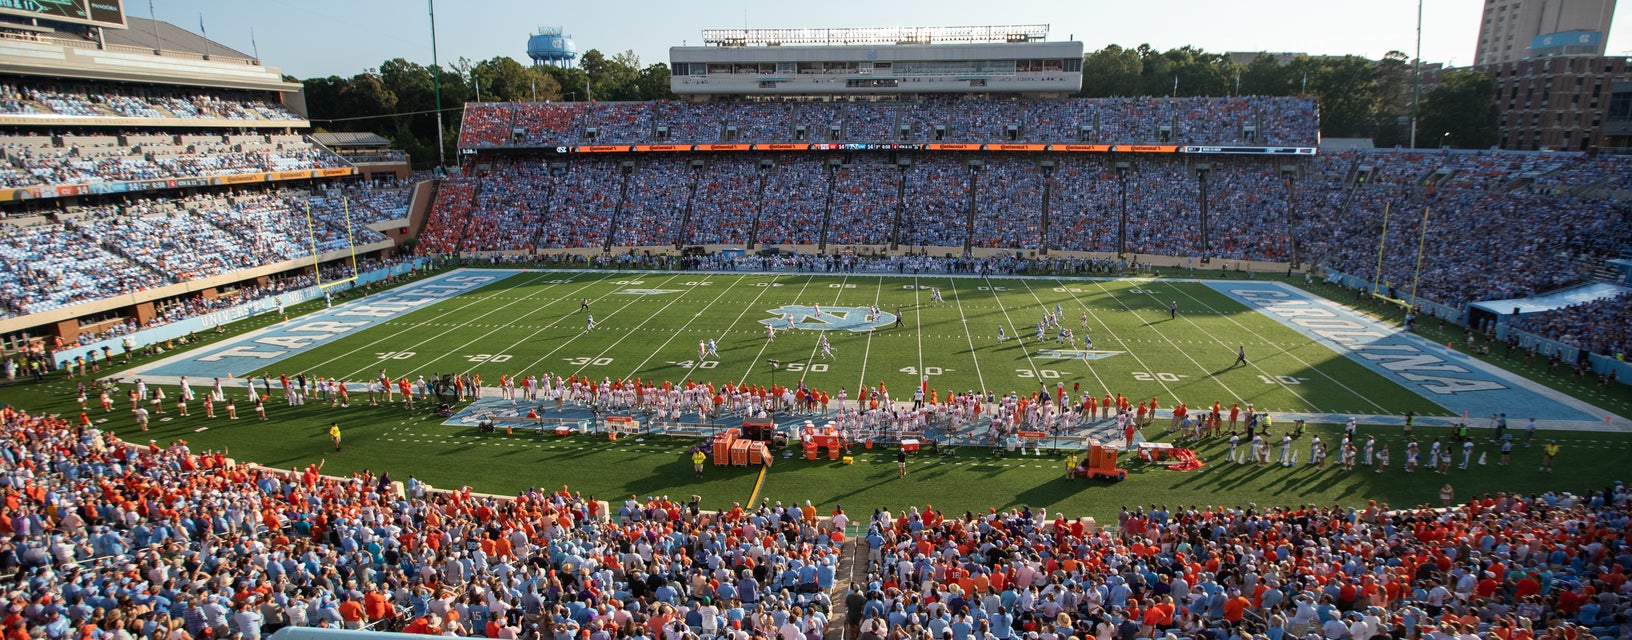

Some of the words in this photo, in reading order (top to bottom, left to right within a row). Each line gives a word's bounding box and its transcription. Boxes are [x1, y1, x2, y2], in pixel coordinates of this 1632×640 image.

[287, 287, 316, 303] NORTH
[195, 319, 372, 362] TAR
[333, 275, 498, 318] HEELS
[1228, 288, 1511, 396] CAROLINA
[376, 351, 416, 359] 10
[466, 354, 512, 362] 20
[571, 357, 614, 366] 30
[676, 360, 719, 369] 40
[786, 363, 828, 372] 50
[899, 366, 943, 375] 40
[1015, 369, 1061, 379] 30
[1132, 372, 1178, 381] 20
[1257, 375, 1301, 384] 10
[472, 611, 482, 621] 15
[512, 613, 518, 624] 1
